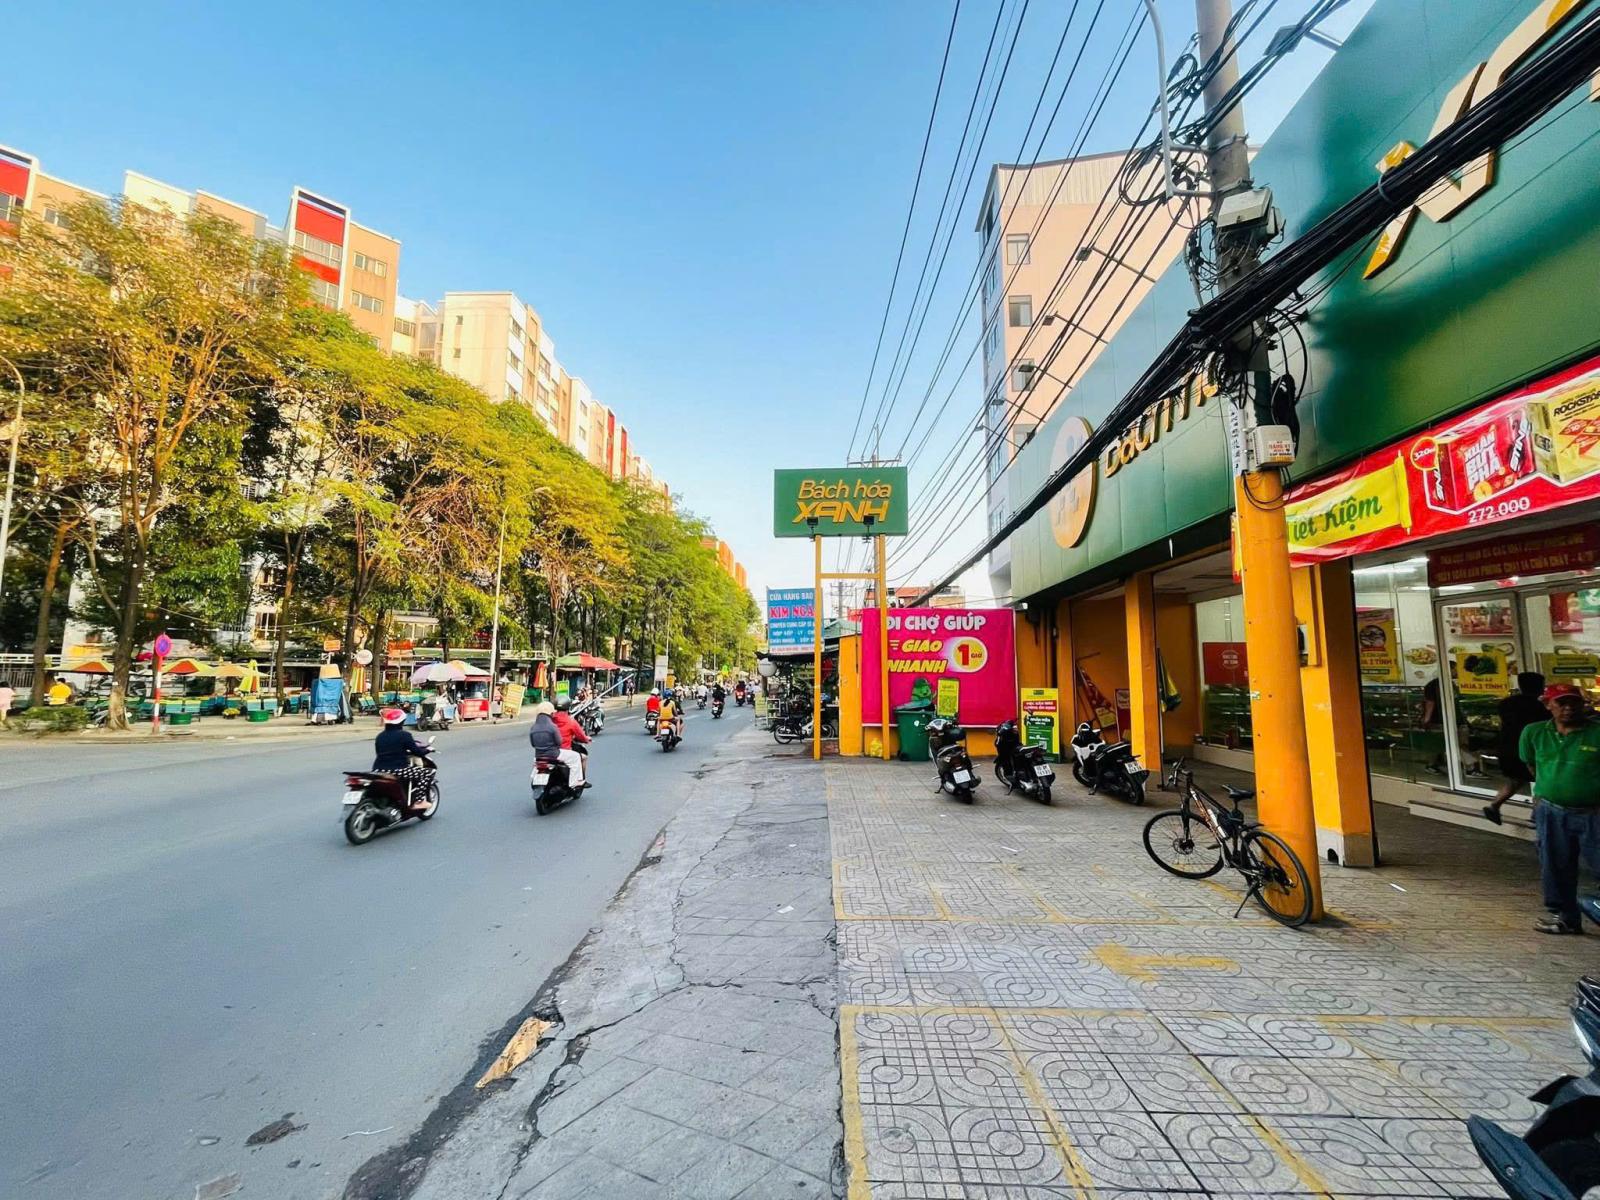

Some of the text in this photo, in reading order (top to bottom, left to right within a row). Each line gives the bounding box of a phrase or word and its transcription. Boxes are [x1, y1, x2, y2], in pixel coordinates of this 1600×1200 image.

[798, 478, 892, 499] Bách hóa
[792, 500, 890, 524] XANH
[1322, 495, 1384, 533] Kiệm
[1468, 496, 1531, 523] 272.000
[769, 605, 790, 618] KIM
[904, 613, 941, 635] CHỢ
[943, 611, 987, 631] GIÚP
[901, 638, 944, 653] GIAO
[957, 643, 970, 666] 1
[887, 659, 948, 673] NHANH
